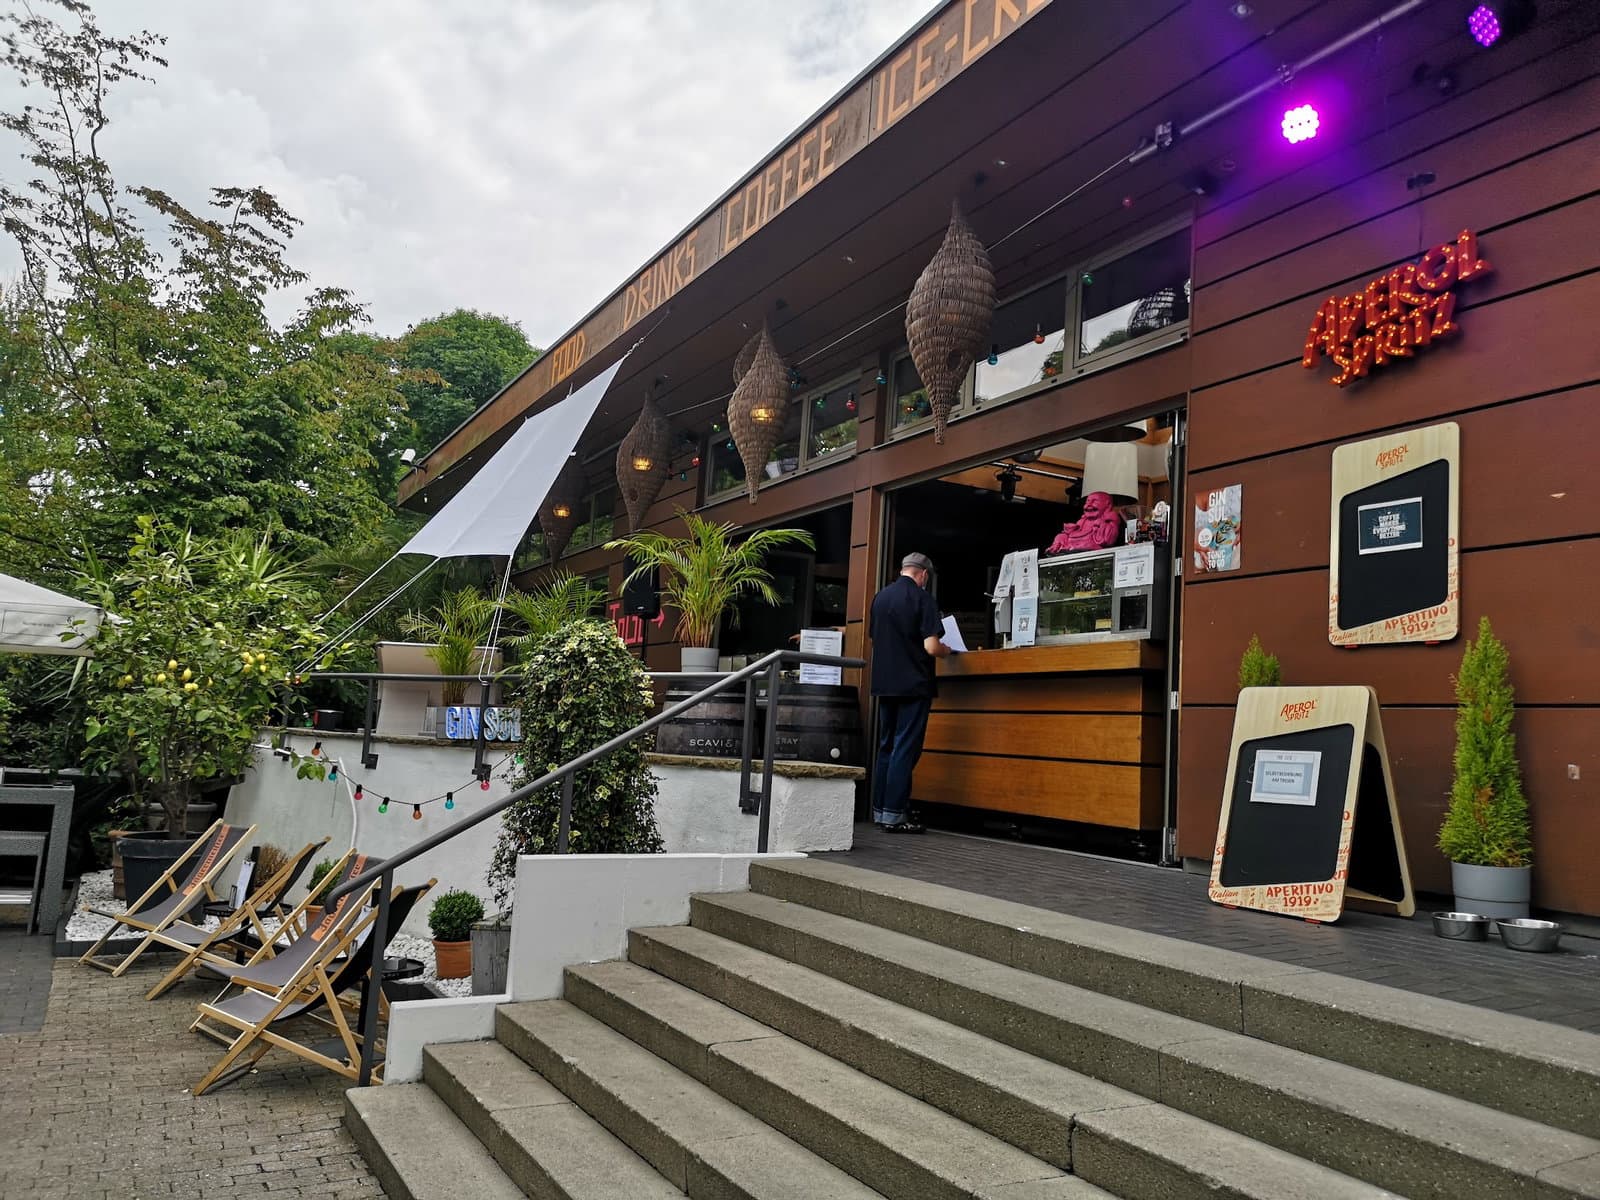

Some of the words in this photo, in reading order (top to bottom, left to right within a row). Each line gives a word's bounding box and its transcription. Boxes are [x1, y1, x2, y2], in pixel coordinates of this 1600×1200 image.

[551, 329, 586, 387] FOOD
[622, 227, 699, 330] DRINKS
[724, 109, 840, 253] COFFEE
[1302, 230, 1494, 368] APEROL
[1328, 290, 1461, 387] SPRITZ
[1375, 444, 1409, 467] APEROL
[1381, 455, 1404, 470] SPRITZ
[1208, 491, 1226, 507] GIN
[1208, 506, 1228, 523] SUL
[1207, 559, 1216, 569] TO
[1216, 558, 1225, 568] GO
[1384, 605, 1448, 631] APERITIVO
[1401, 621, 1429, 636] 1919
[1280, 700, 1315, 717] APEROL
[1285, 710, 1309, 722] SPRITZ
[446, 706, 480, 740] GIN
[484, 707, 521, 742] SUL
[689, 738, 724, 748] SCAVI
[1266, 884, 1334, 898] APERITIVO
[1283, 896, 1312, 907] 1919
